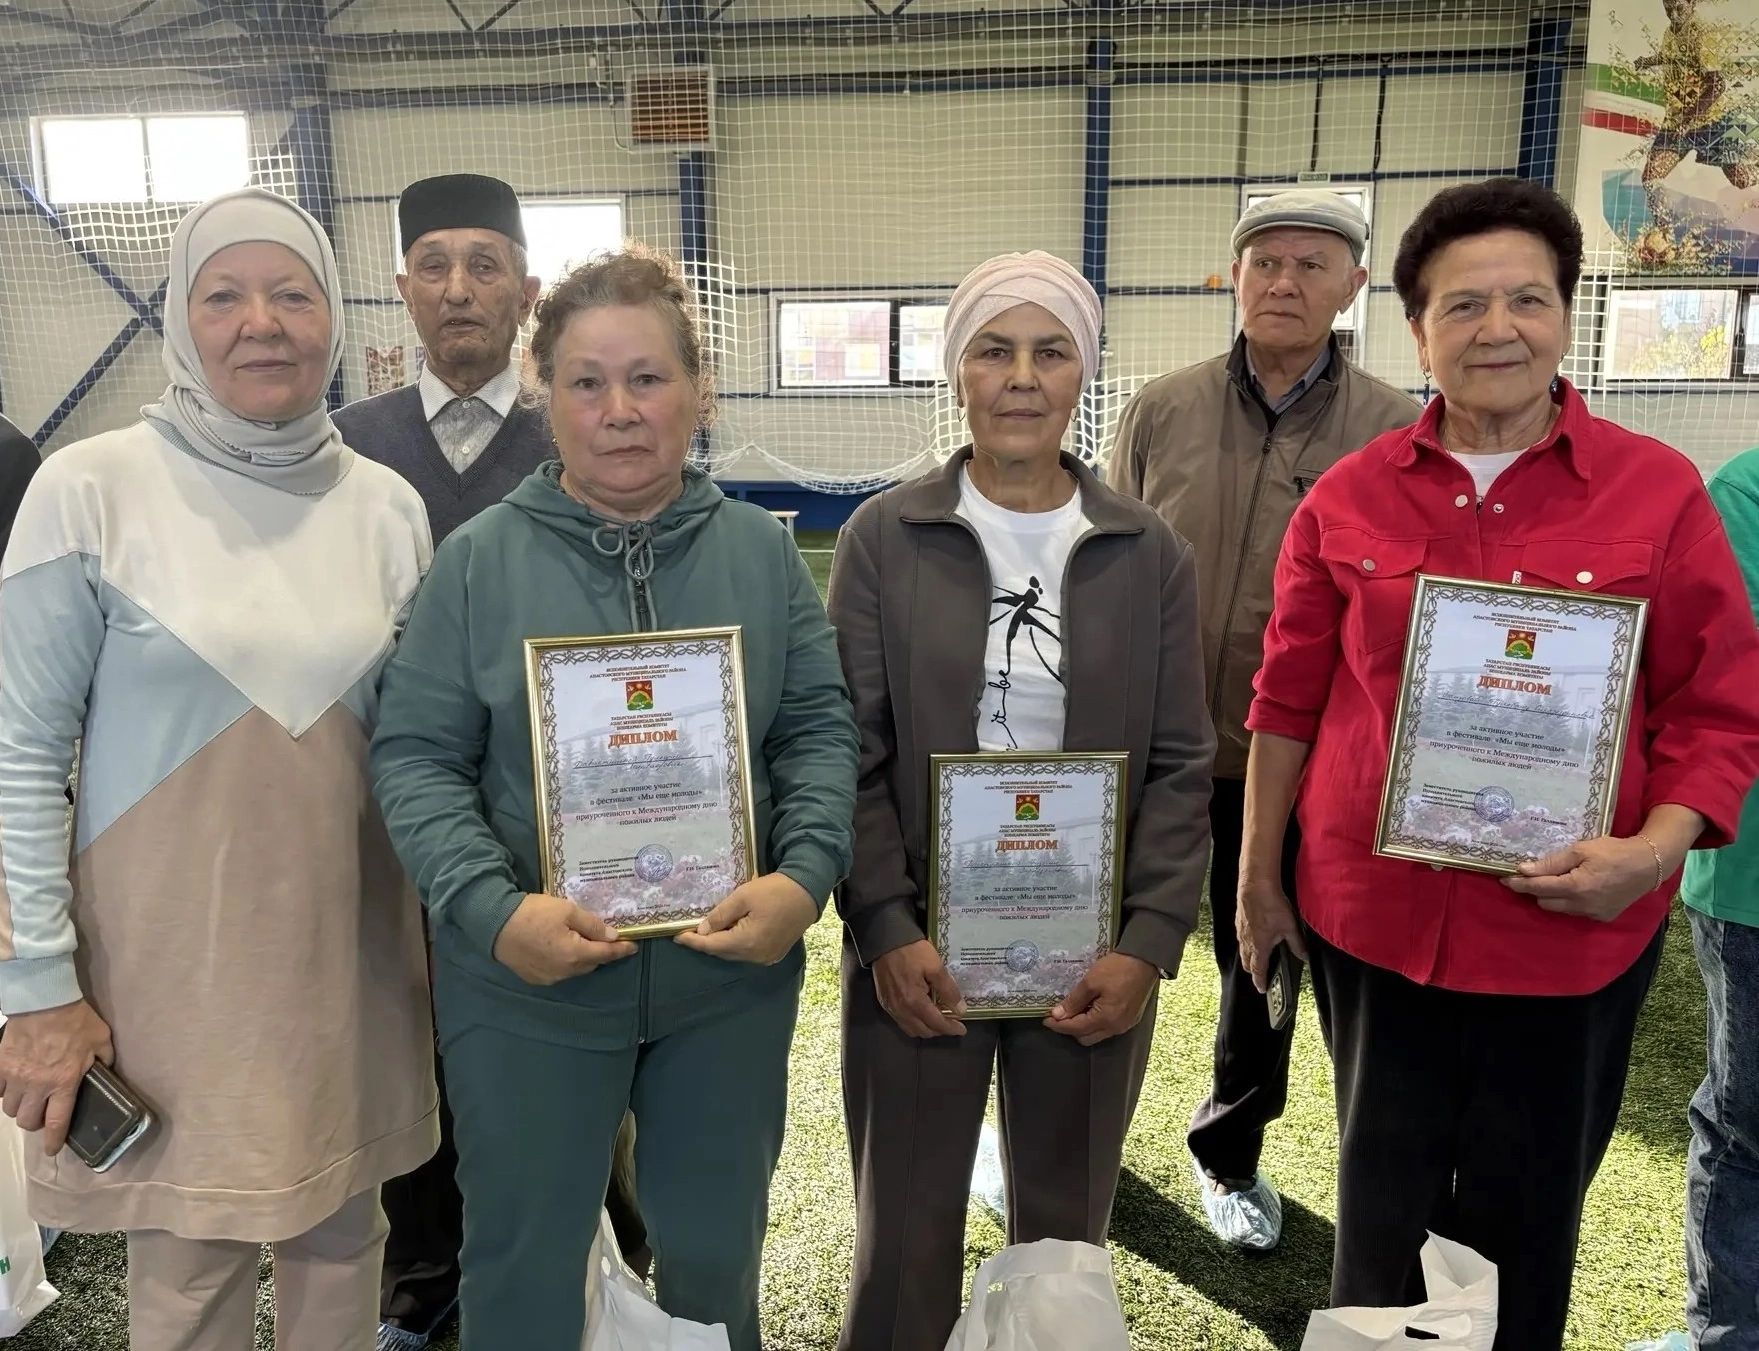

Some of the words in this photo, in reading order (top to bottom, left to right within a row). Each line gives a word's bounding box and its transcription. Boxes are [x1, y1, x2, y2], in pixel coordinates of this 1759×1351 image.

[1476, 675, 1552, 696] ДИПЛОМ
[608, 730, 678, 749] ДИПЛОМ
[1478, 726, 1513, 736] активное
[1514, 731, 1544, 740] участие
[1514, 740, 1530, 749] еще
[1429, 741, 1486, 755] приуроченного
[1493, 749, 1561, 766] Международному
[1472, 756, 1506, 767] пожилых
[1507, 761, 1532, 770] людей
[619, 785, 653, 793] активное
[654, 782, 681, 790] участие
[655, 792, 670, 800] еще
[576, 810, 631, 821] приуроченного
[638, 804, 701, 815] Международному
[619, 818, 652, 826] пожилых
[653, 815, 677, 823] людей
[995, 840, 1058, 853] ДИПЛОМ
